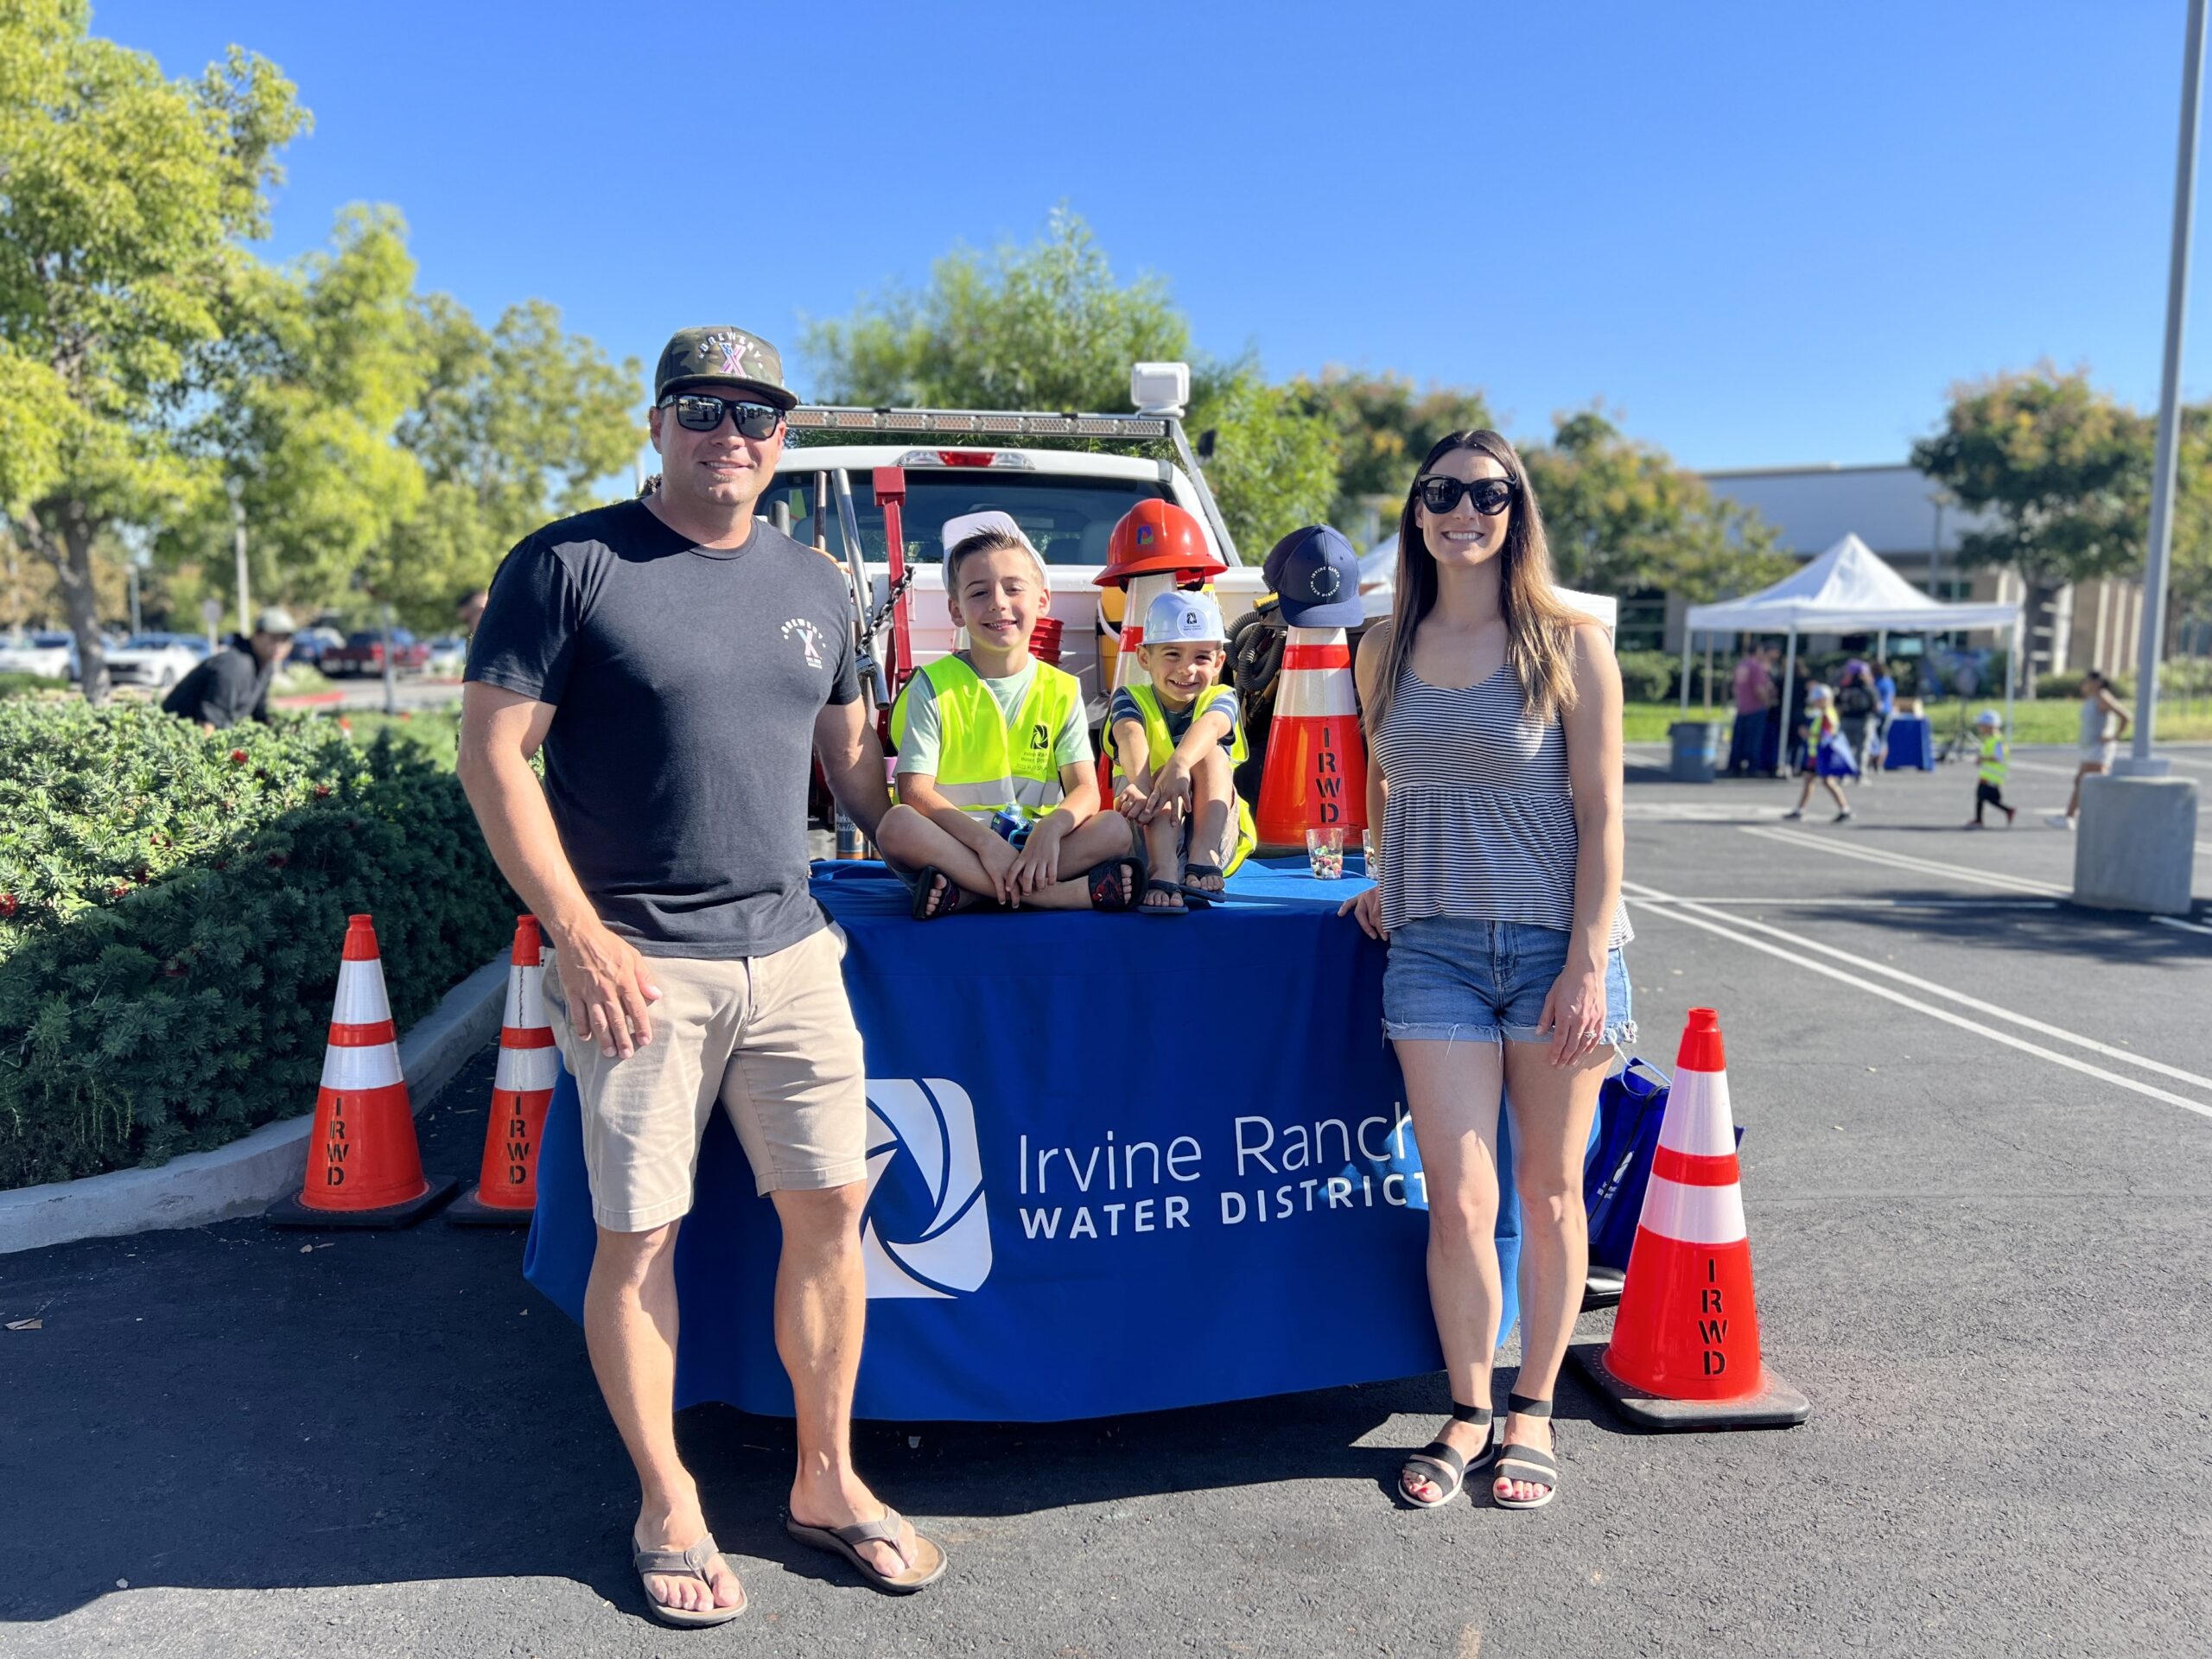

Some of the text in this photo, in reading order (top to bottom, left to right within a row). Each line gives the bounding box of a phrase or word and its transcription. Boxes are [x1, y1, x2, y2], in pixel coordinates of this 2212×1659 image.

[700, 332, 761, 359] BREWERY
[1311, 566, 1326, 579] IRVINE
[1315, 728, 1341, 823] IRWD
[326, 1096, 350, 1186] IRWD
[506, 1095, 530, 1185] IRWD
[1020, 1130, 1202, 1195] Irvine
[1020, 1171, 1429, 1239] WATER DISTRICT
[1698, 1258, 1728, 1376] IRWD
